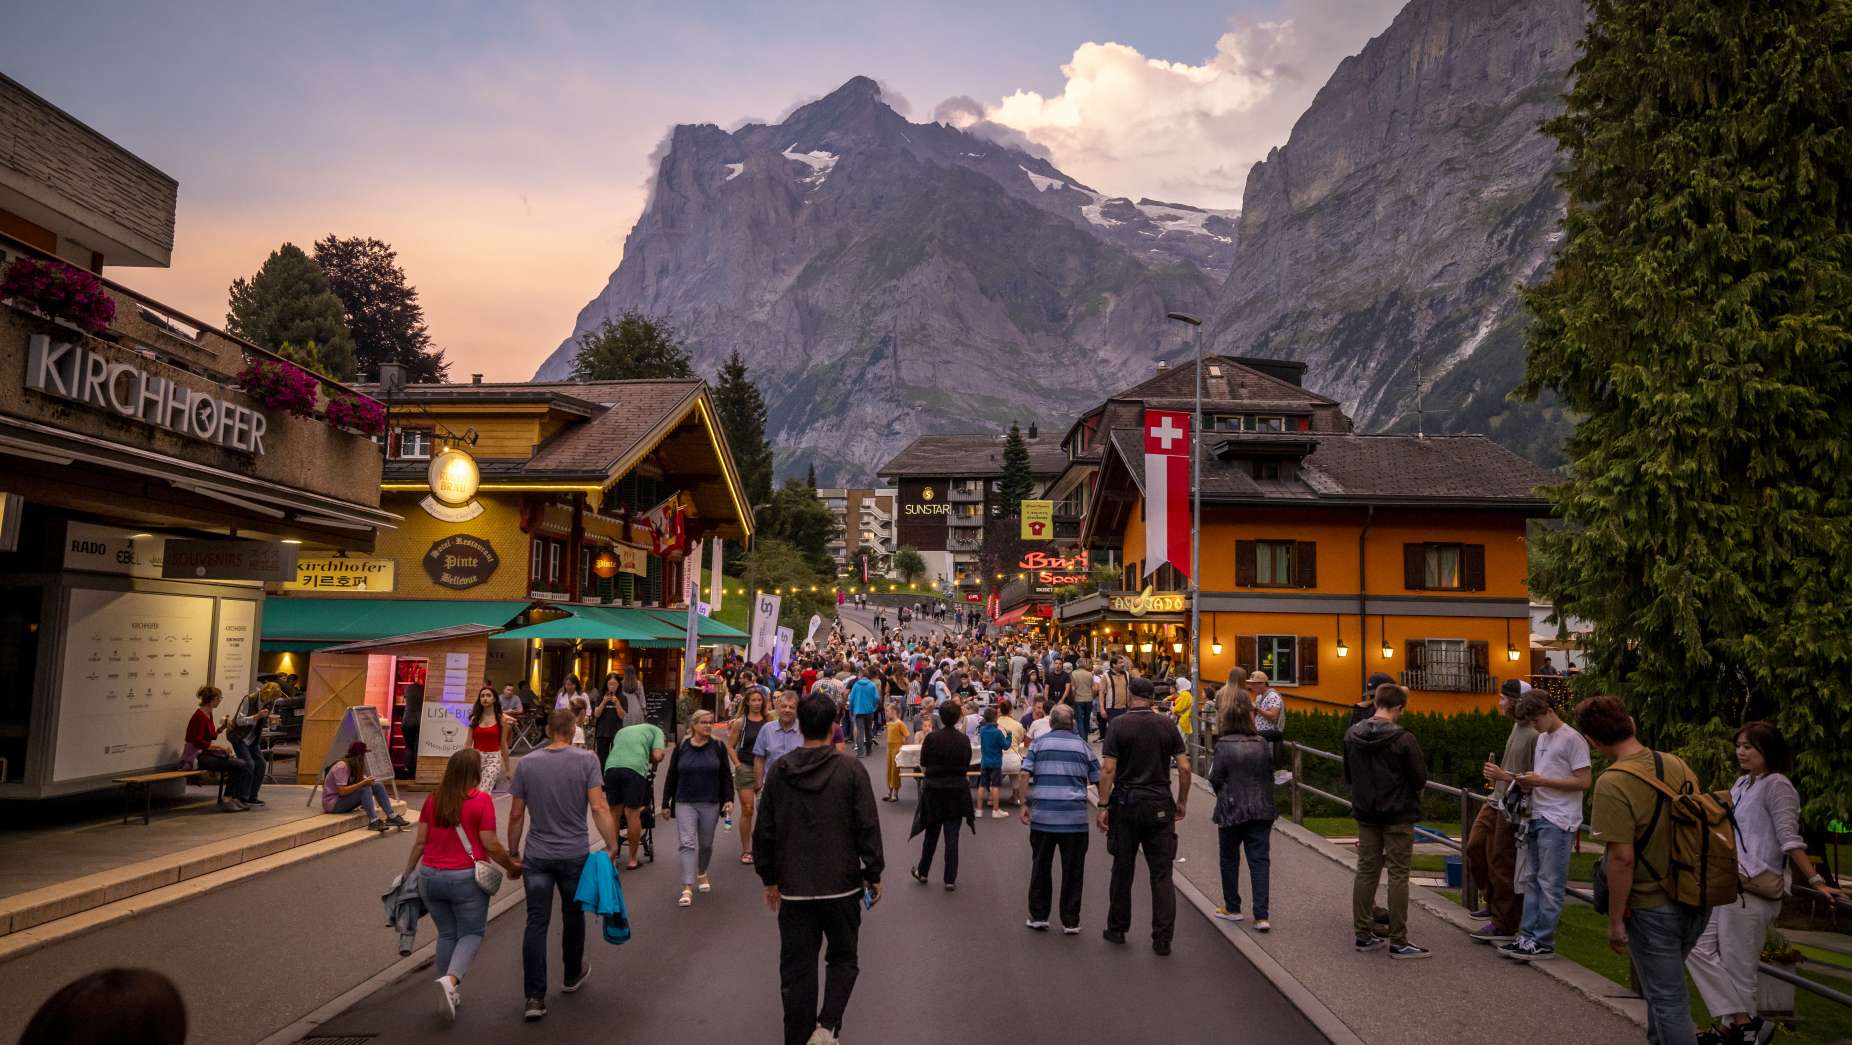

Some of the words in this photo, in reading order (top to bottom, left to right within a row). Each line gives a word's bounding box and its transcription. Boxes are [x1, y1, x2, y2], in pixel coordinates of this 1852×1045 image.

[26, 334, 266, 456] KIRCHHOFER
[905, 504, 950, 515] SUNSTAR
[71, 539, 106, 556] RADO
[443, 554, 479, 569] Pinte
